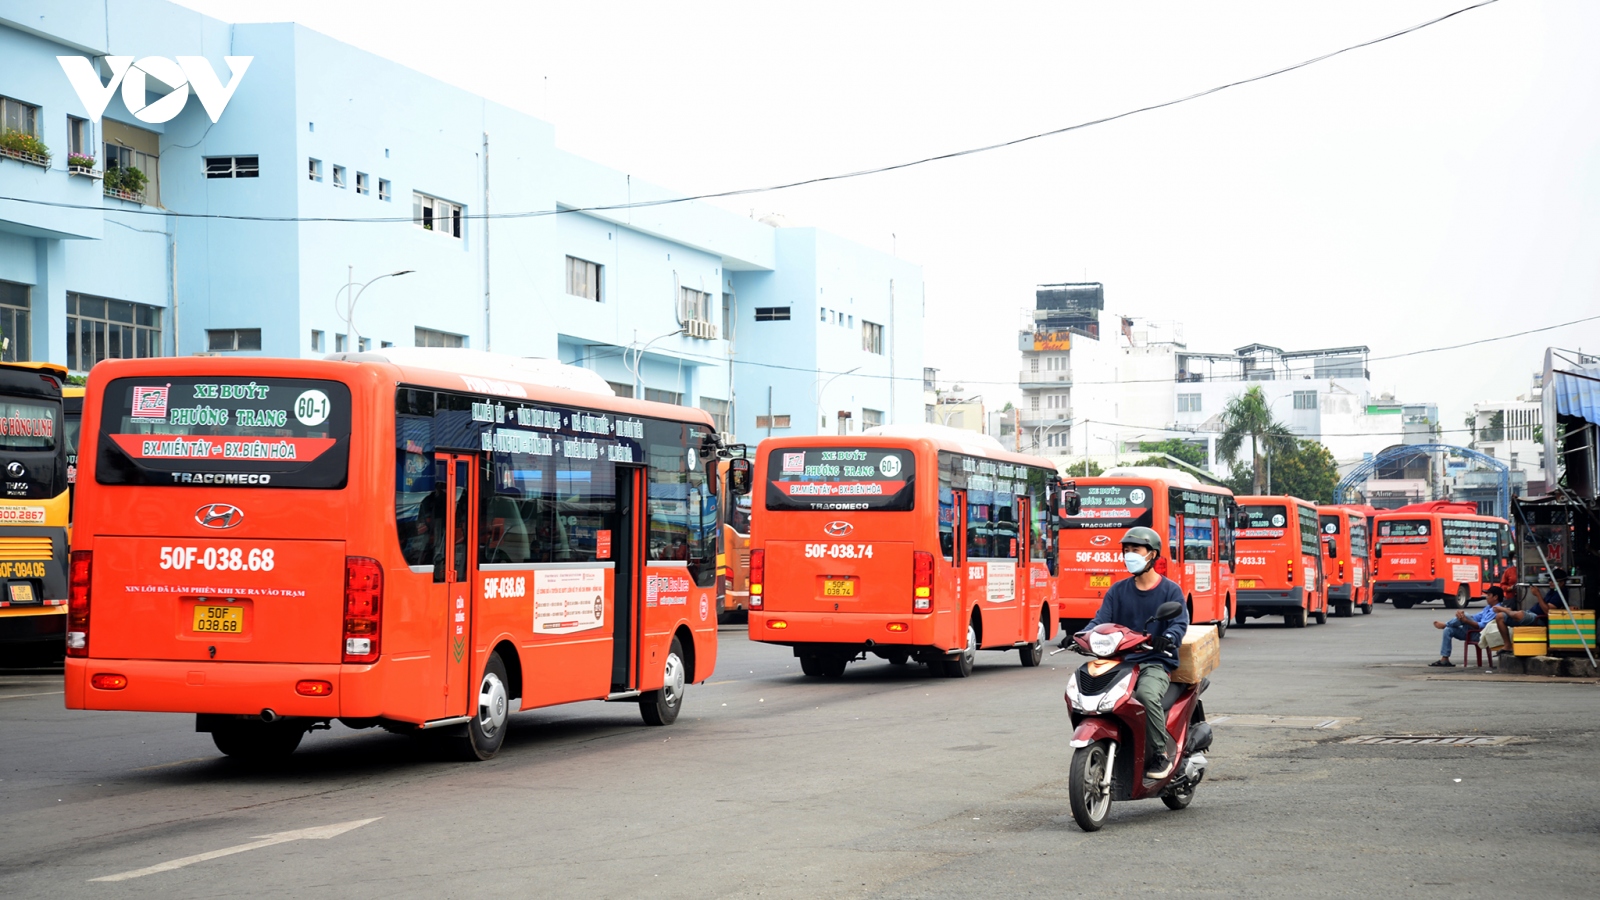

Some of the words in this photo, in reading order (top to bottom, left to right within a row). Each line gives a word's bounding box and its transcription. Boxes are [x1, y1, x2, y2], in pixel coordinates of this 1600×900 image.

[193, 384, 217, 398] XE
[220, 382, 269, 399] BUÝT
[298, 397, 326, 418] 60-1
[170, 405, 229, 425] PHƯƠNG
[236, 409, 287, 427] TRANG
[0, 416, 8, 436] G
[8, 410, 32, 436] HỒNG
[33, 418, 52, 437] LINH
[142, 438, 190, 456] BX.MIỀN
[191, 440, 211, 457] TÂY
[224, 440, 270, 458] BX.BIÊN
[271, 441, 296, 459] HÒA
[822, 451, 836, 460] XE
[838, 450, 867, 460] BUÝT
[805, 464, 840, 476] PHƯƠNG
[844, 466, 874, 476] TRANG
[882, 461, 899, 472] 60-1
[172, 472, 271, 484] TRACOMECO
[790, 483, 820, 494] BX.MIỀN
[820, 484, 832, 494] TÂY
[839, 483, 865, 494] BX.BIÊN
[867, 483, 882, 494] HÒA
[1080, 496, 1102, 505] HƯƠNG
[805, 544, 873, 558] 50F-038.74
[1076, 552, 1124, 562] 50F-038.14
[160, 546, 274, 571] 50F-038.68
[484, 577, 526, 599] 50F-038.68
[208, 608, 229, 618] 50F
[198, 620, 237, 631] 038.68
